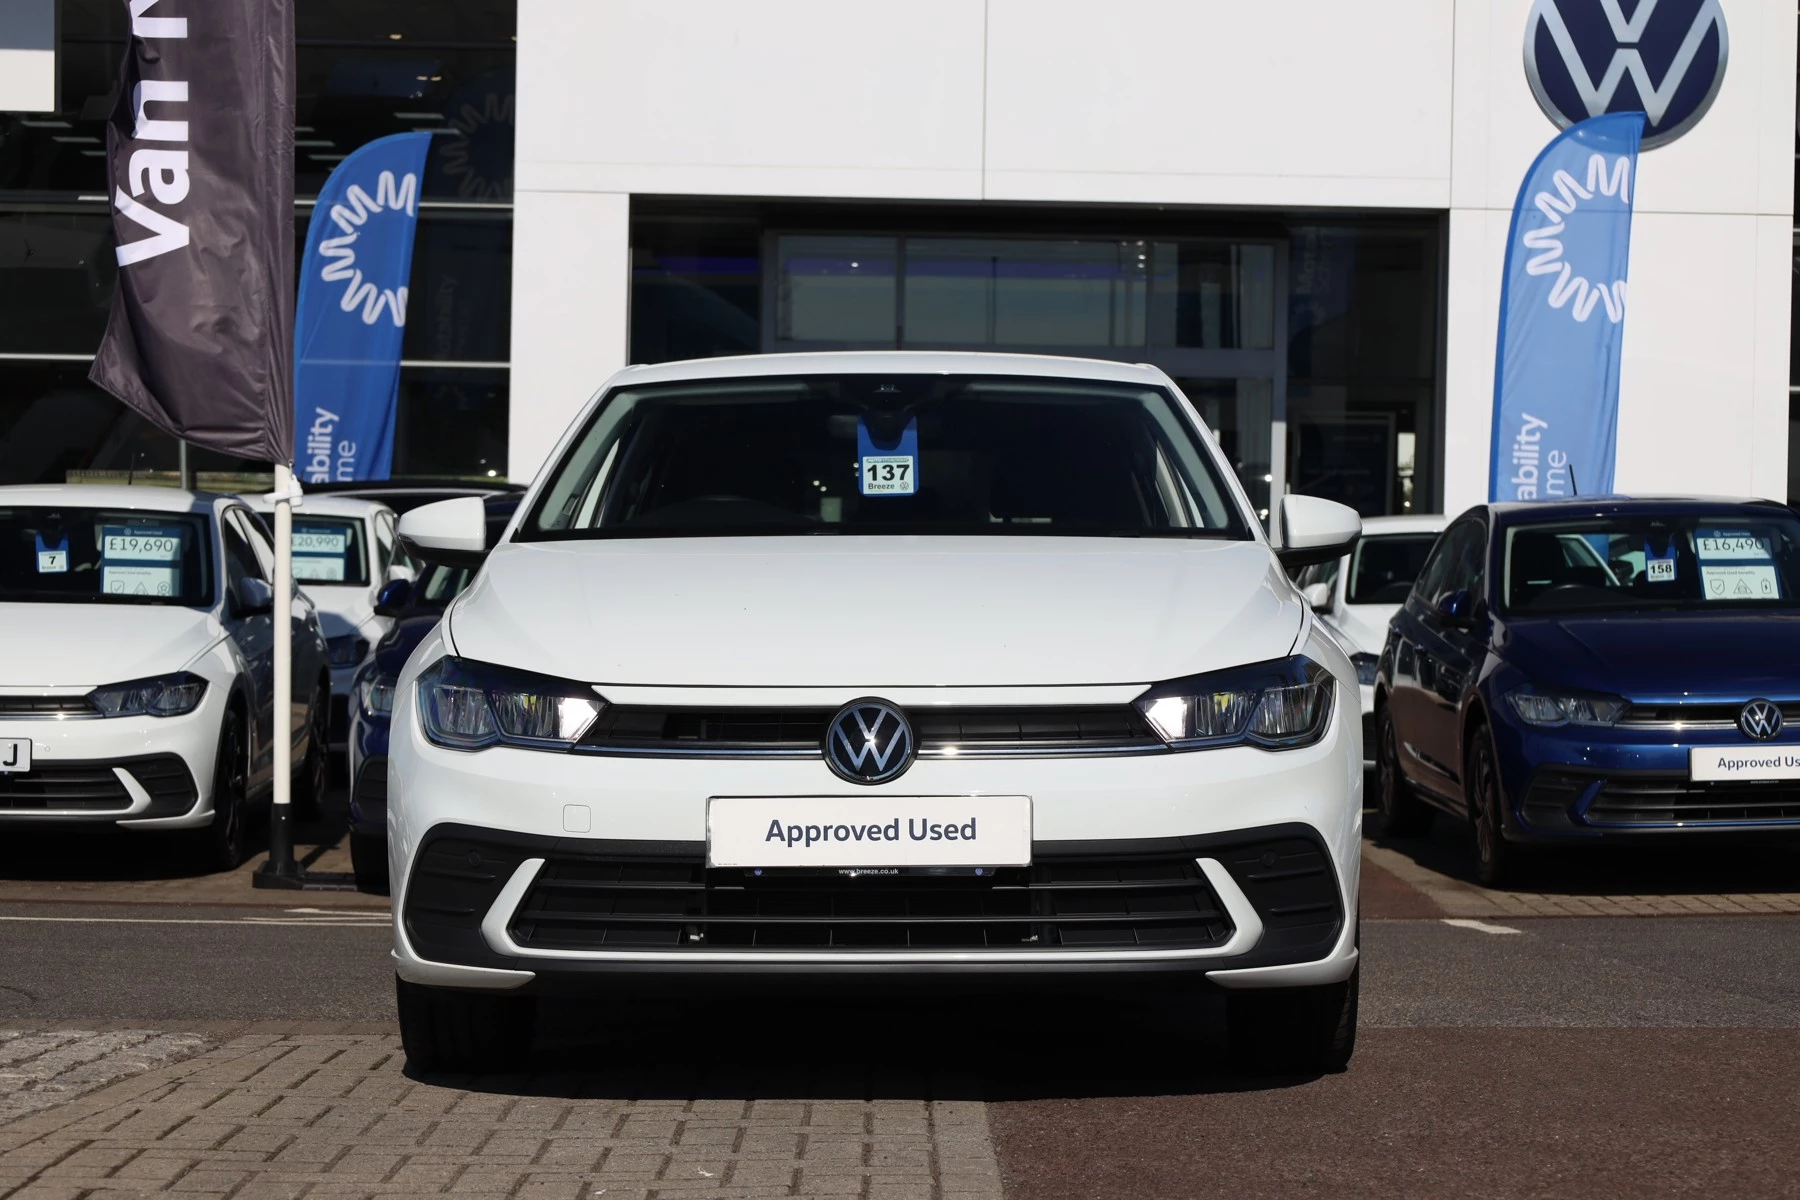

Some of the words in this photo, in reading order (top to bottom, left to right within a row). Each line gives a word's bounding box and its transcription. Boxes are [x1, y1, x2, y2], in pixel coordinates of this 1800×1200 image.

[114, 80, 190, 267] Van
[306, 406, 339, 484] ability
[1511, 412, 1548, 501] ability
[867, 464, 910, 481] 137
[1546, 450, 1567, 495] me
[868, 482, 895, 490] Breeze
[109, 537, 174, 554] £19,690
[1703, 538, 1765, 552] £16,490
[49, 555, 56, 565] 7
[1650, 564, 1672, 574] 158
[3, 743, 18, 767] J
[1717, 756, 1781, 771] Approved
[765, 817, 900, 848] Approved
[908, 817, 977, 842] Used
